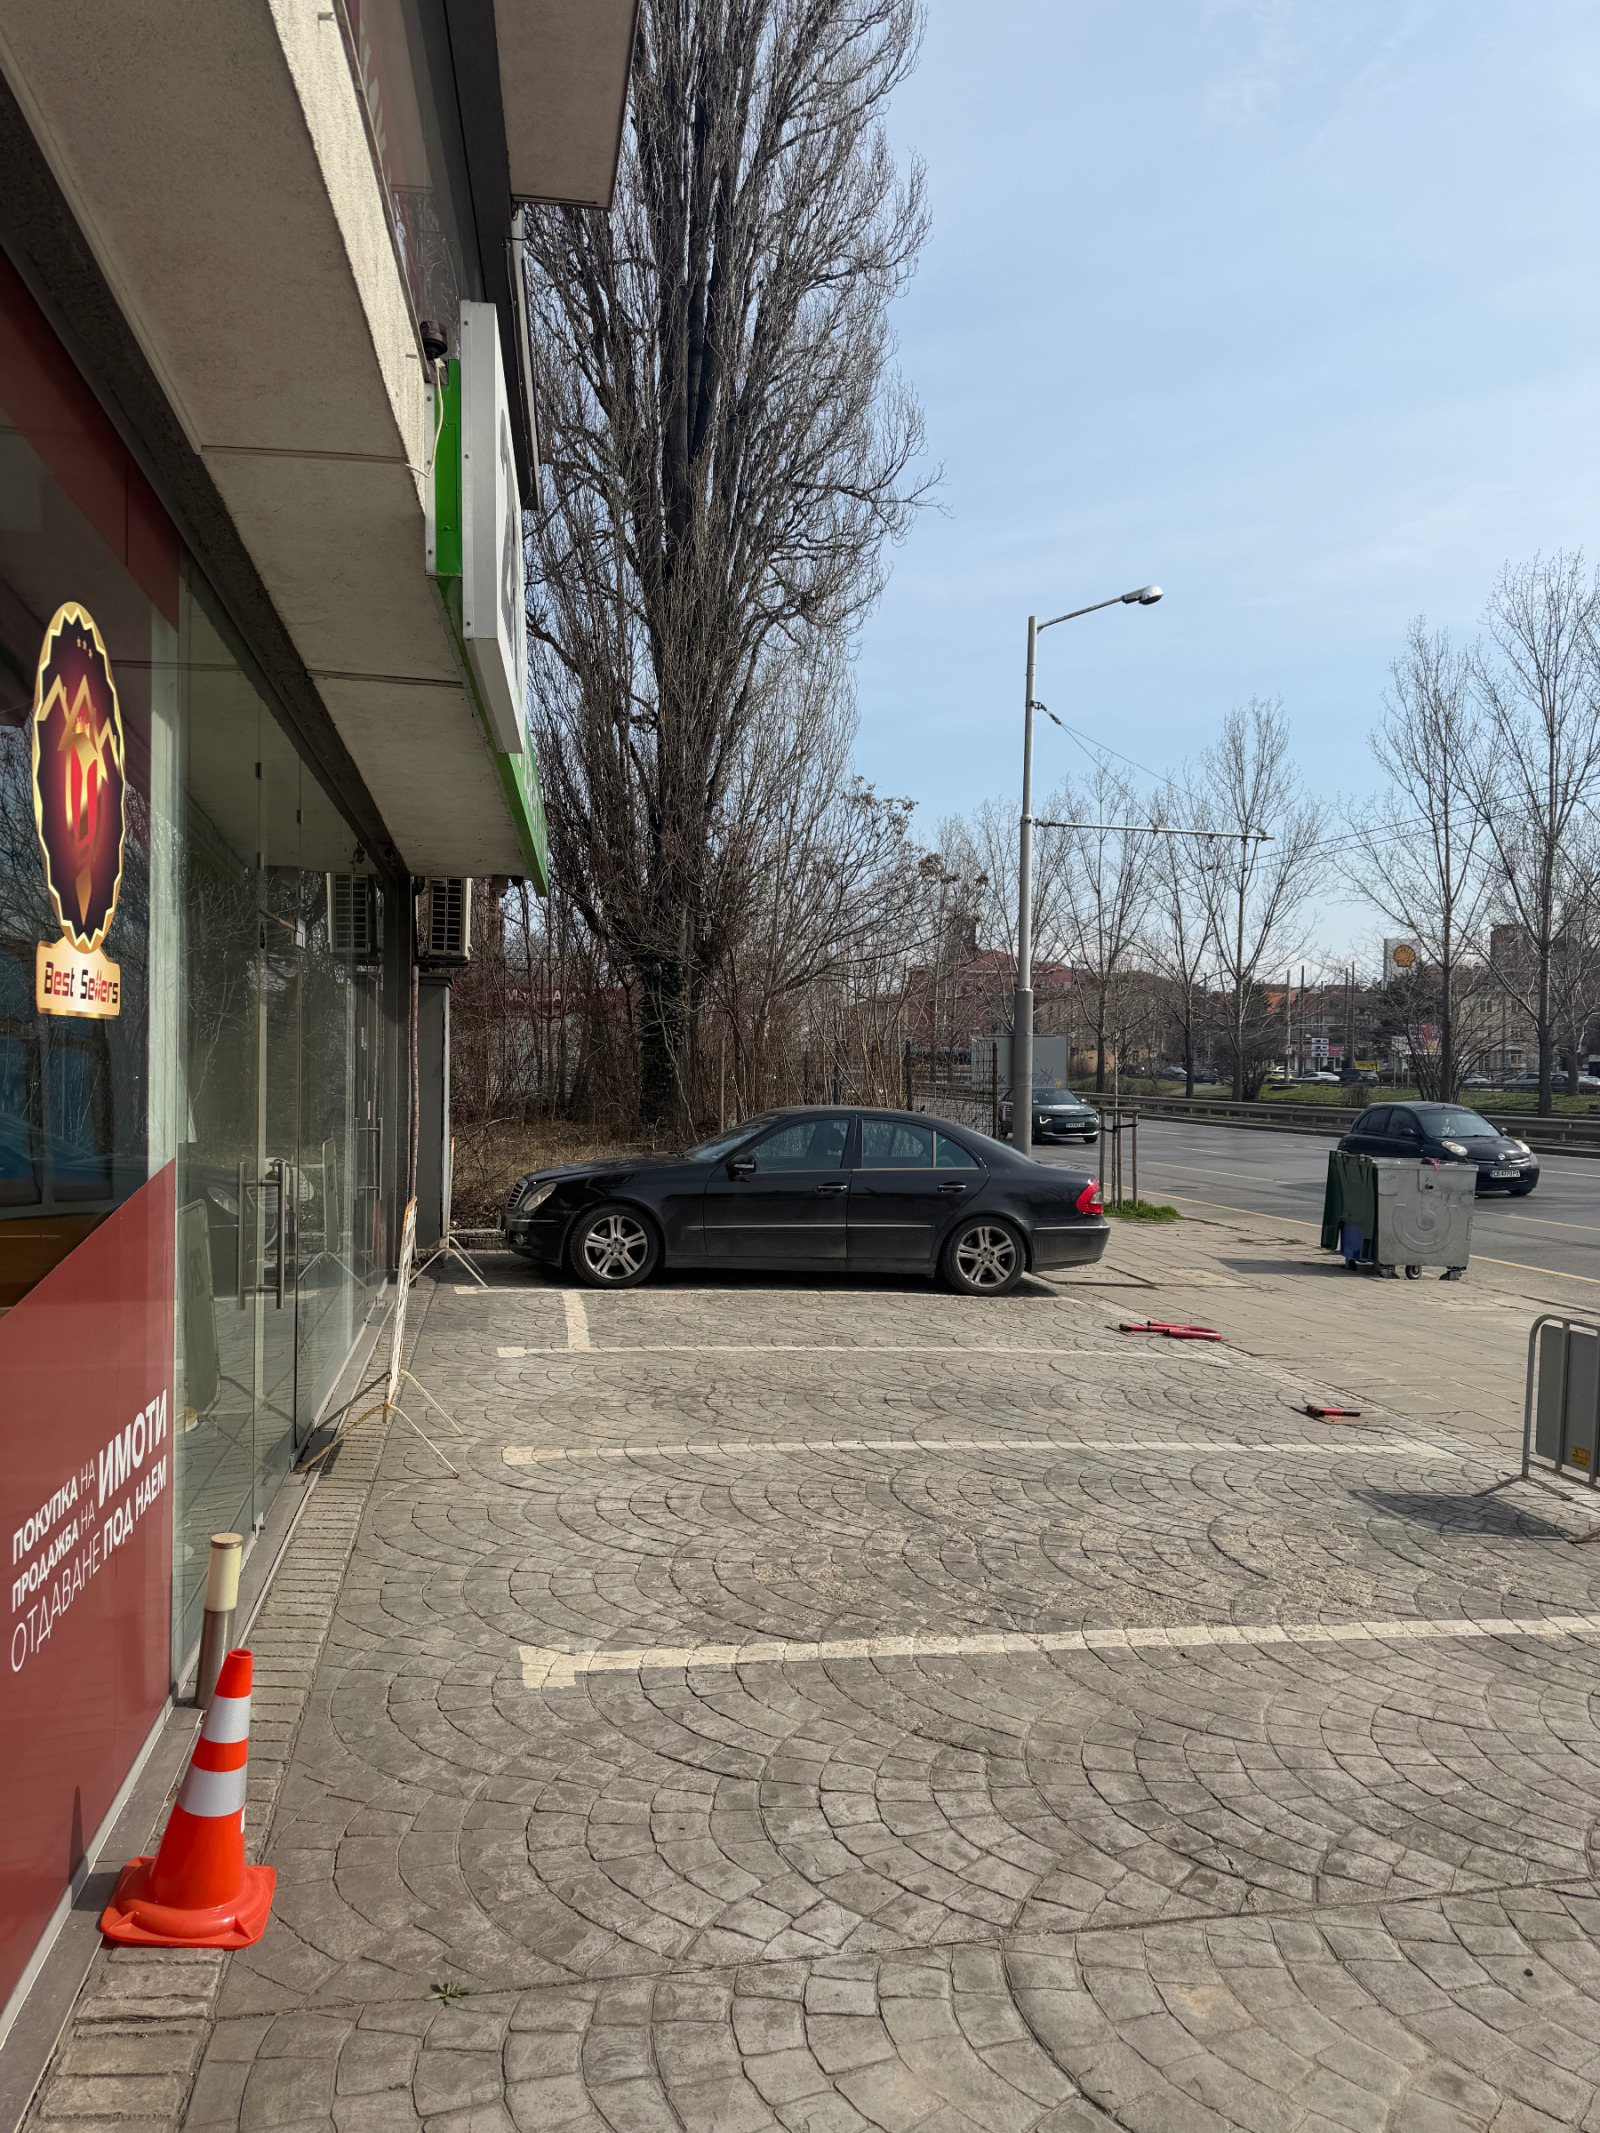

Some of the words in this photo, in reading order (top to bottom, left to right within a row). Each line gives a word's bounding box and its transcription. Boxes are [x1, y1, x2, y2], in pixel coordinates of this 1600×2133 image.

[44, 961, 75, 997] Best
[80, 968, 119, 1004] Sellers
[13, 1475, 79, 1565] ПОКУПКА
[80, 1458, 96, 1495] НА
[98, 1388, 167, 1509] ИМОТИ
[11, 1531, 101, 1673] ОТДАВАНЕ
[103, 1497, 134, 1561] ПОД
[135, 1454, 167, 1522] НАЕМ
[12, 1518, 79, 1613] ПРОДАЖБА
[80, 1499, 96, 1536] НА
